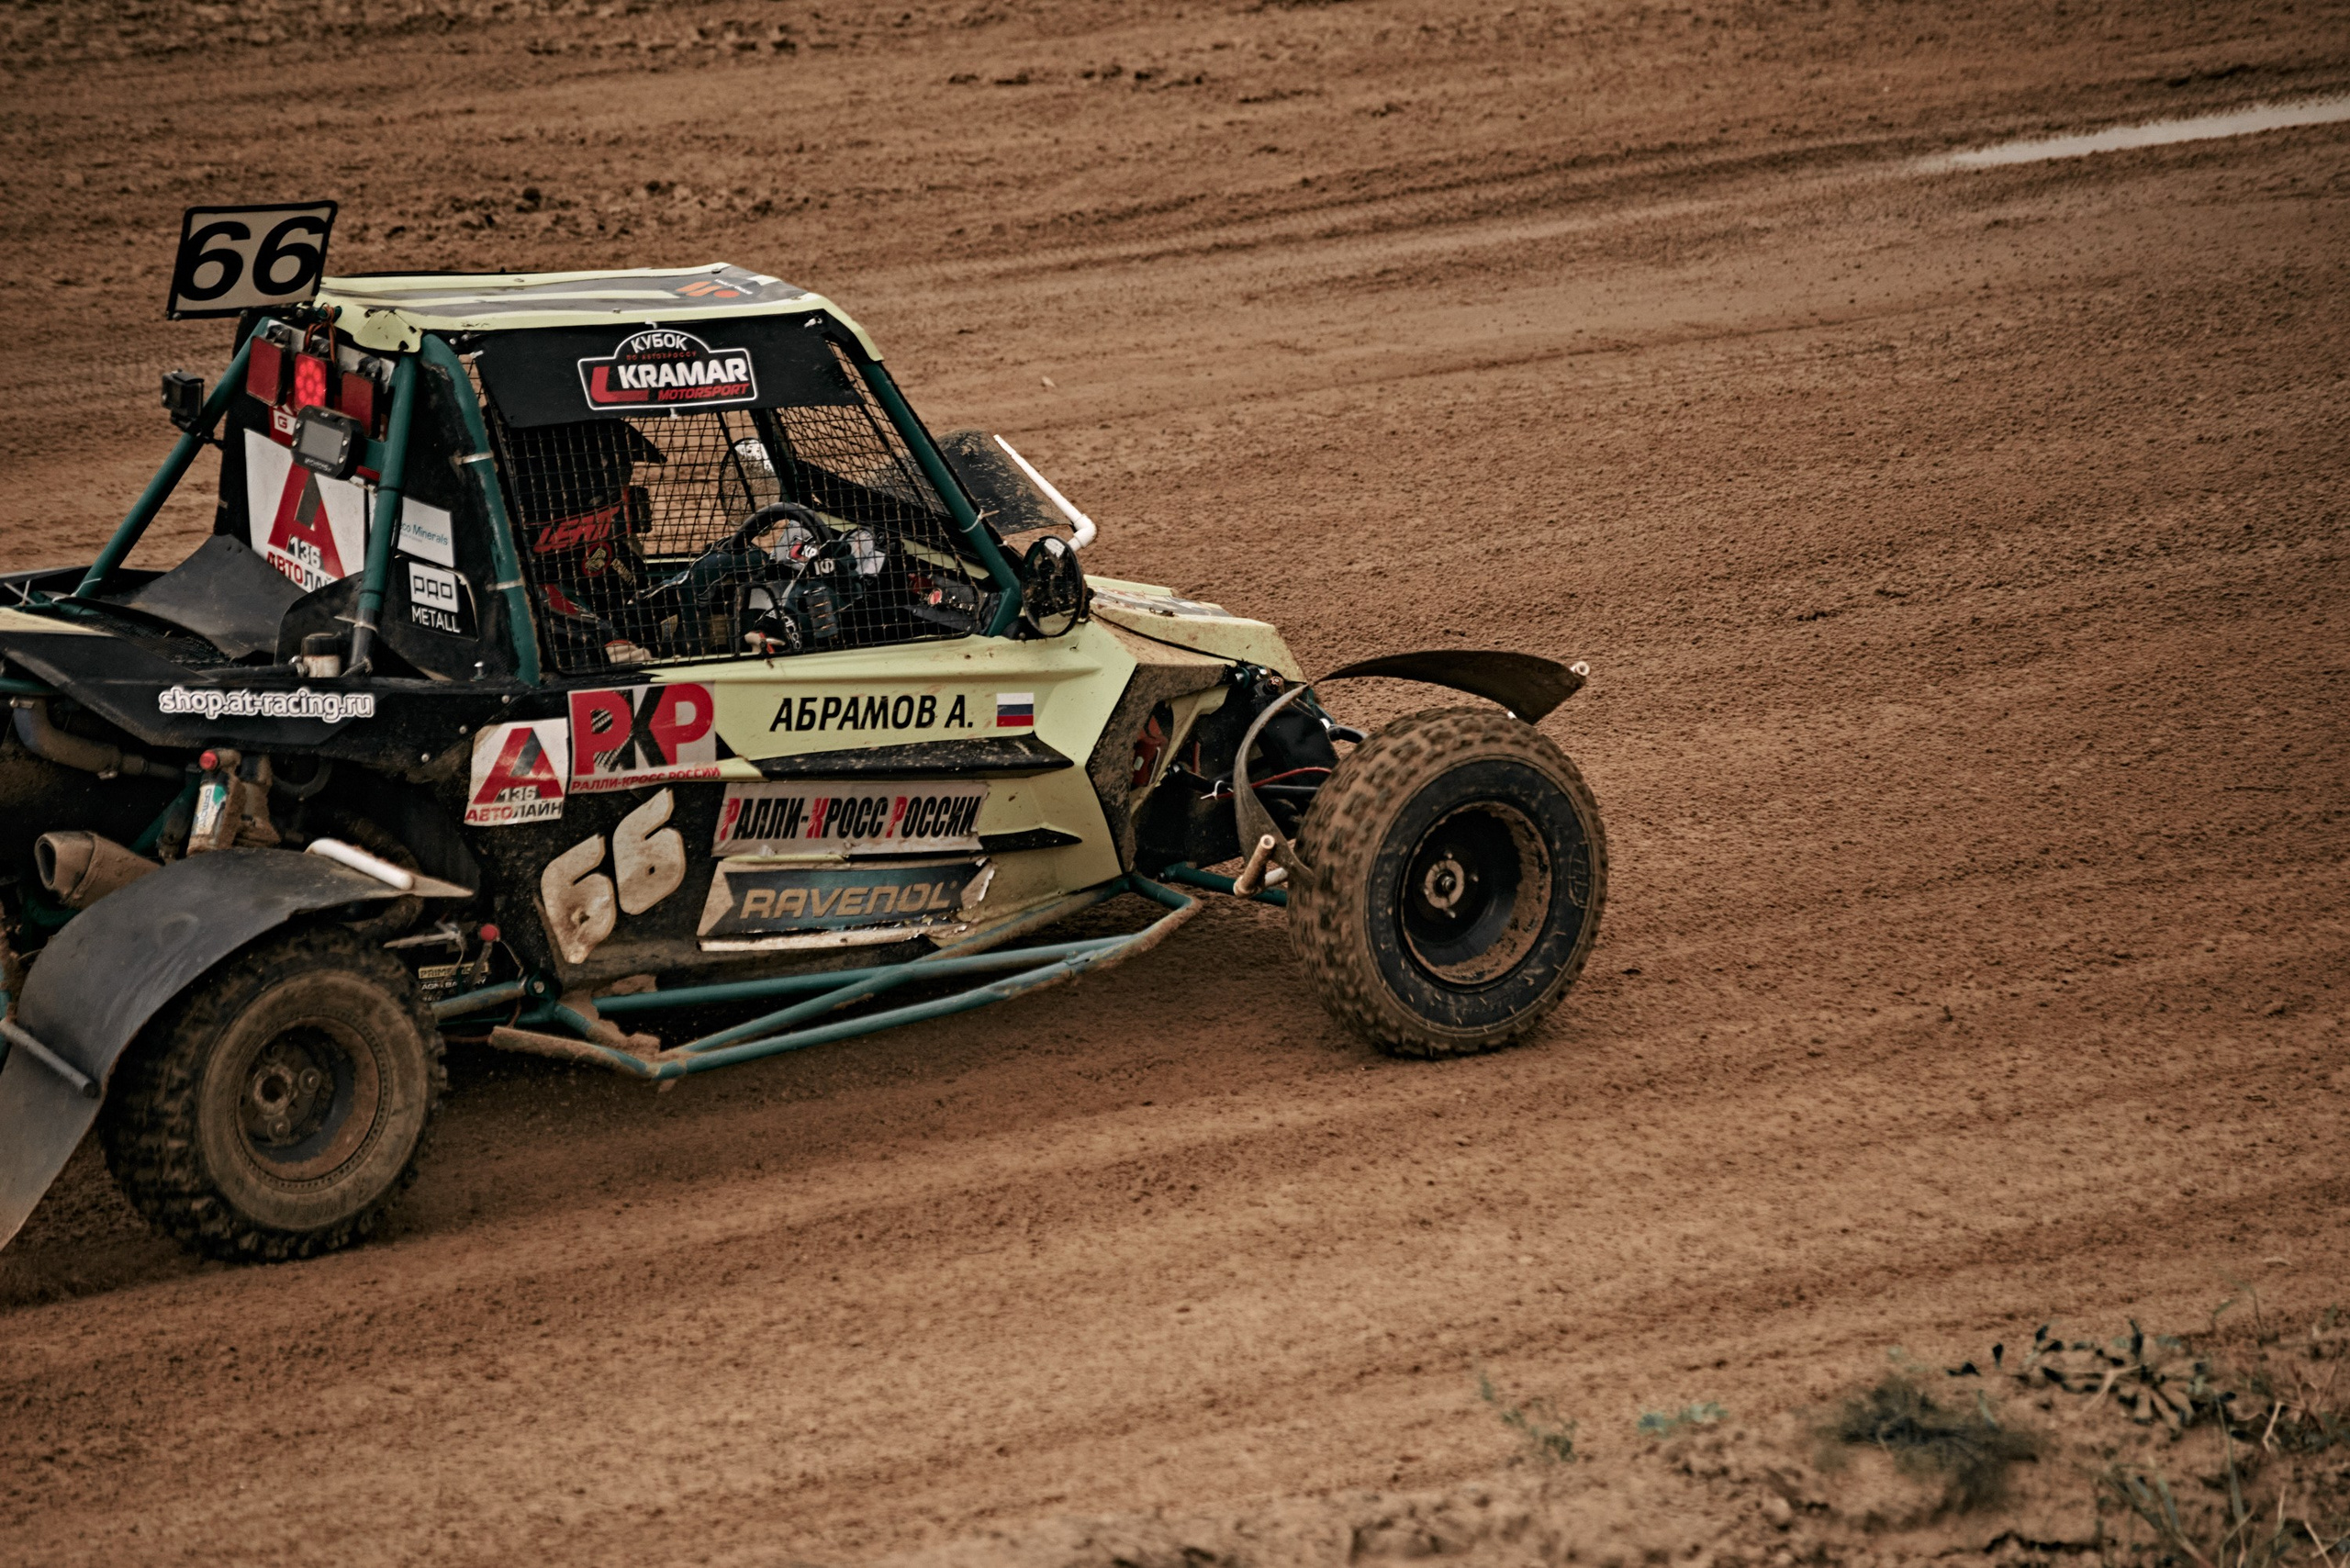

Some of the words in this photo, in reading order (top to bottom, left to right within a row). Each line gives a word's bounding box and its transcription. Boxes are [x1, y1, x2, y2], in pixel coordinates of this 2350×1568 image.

[178, 216, 326, 301] 66
[631, 332, 688, 353] КУБОК
[618, 358, 748, 388] KRAMAR
[657, 383, 750, 400] MOTORSPORT
[412, 524, 448, 545] Minerals
[411, 605, 461, 634] METALL
[159, 686, 375, 723] shop.at-racing.ru
[769, 695, 937, 733] АБРАМОВ
[944, 694, 974, 729] А.
[499, 786, 536, 802] 136
[571, 773, 666, 792] РАЛЛИ-КРОСС
[667, 767, 721, 780] РОССИИ
[464, 800, 563, 823] АВТОЛАЙН
[720, 797, 889, 841] РАЛЛИ-КРОСС
[886, 795, 981, 839] РОССИИ
[541, 787, 687, 964] 66
[740, 881, 953, 920] RAVENOL
